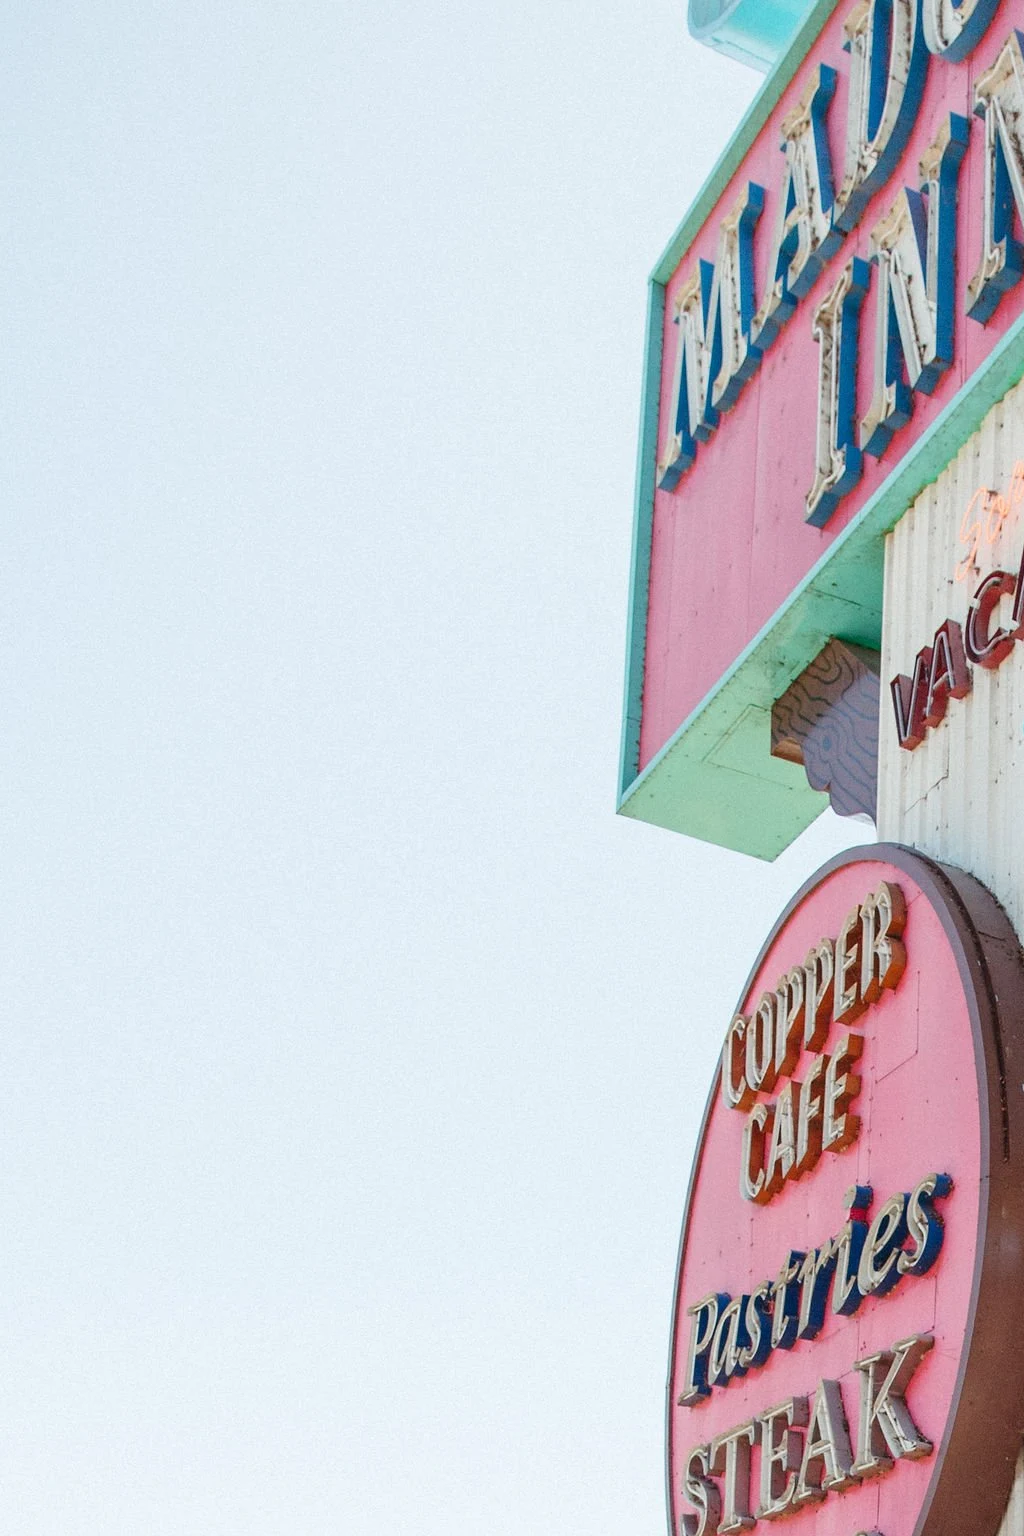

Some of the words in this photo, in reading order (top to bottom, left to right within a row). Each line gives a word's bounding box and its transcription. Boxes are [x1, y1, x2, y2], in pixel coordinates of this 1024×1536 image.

[658, 0, 1002, 492] MAD
[721, 880, 908, 1112] COPPER
[739, 1033, 865, 1206] CAFE
[677, 1172, 953, 1407] Pastries
